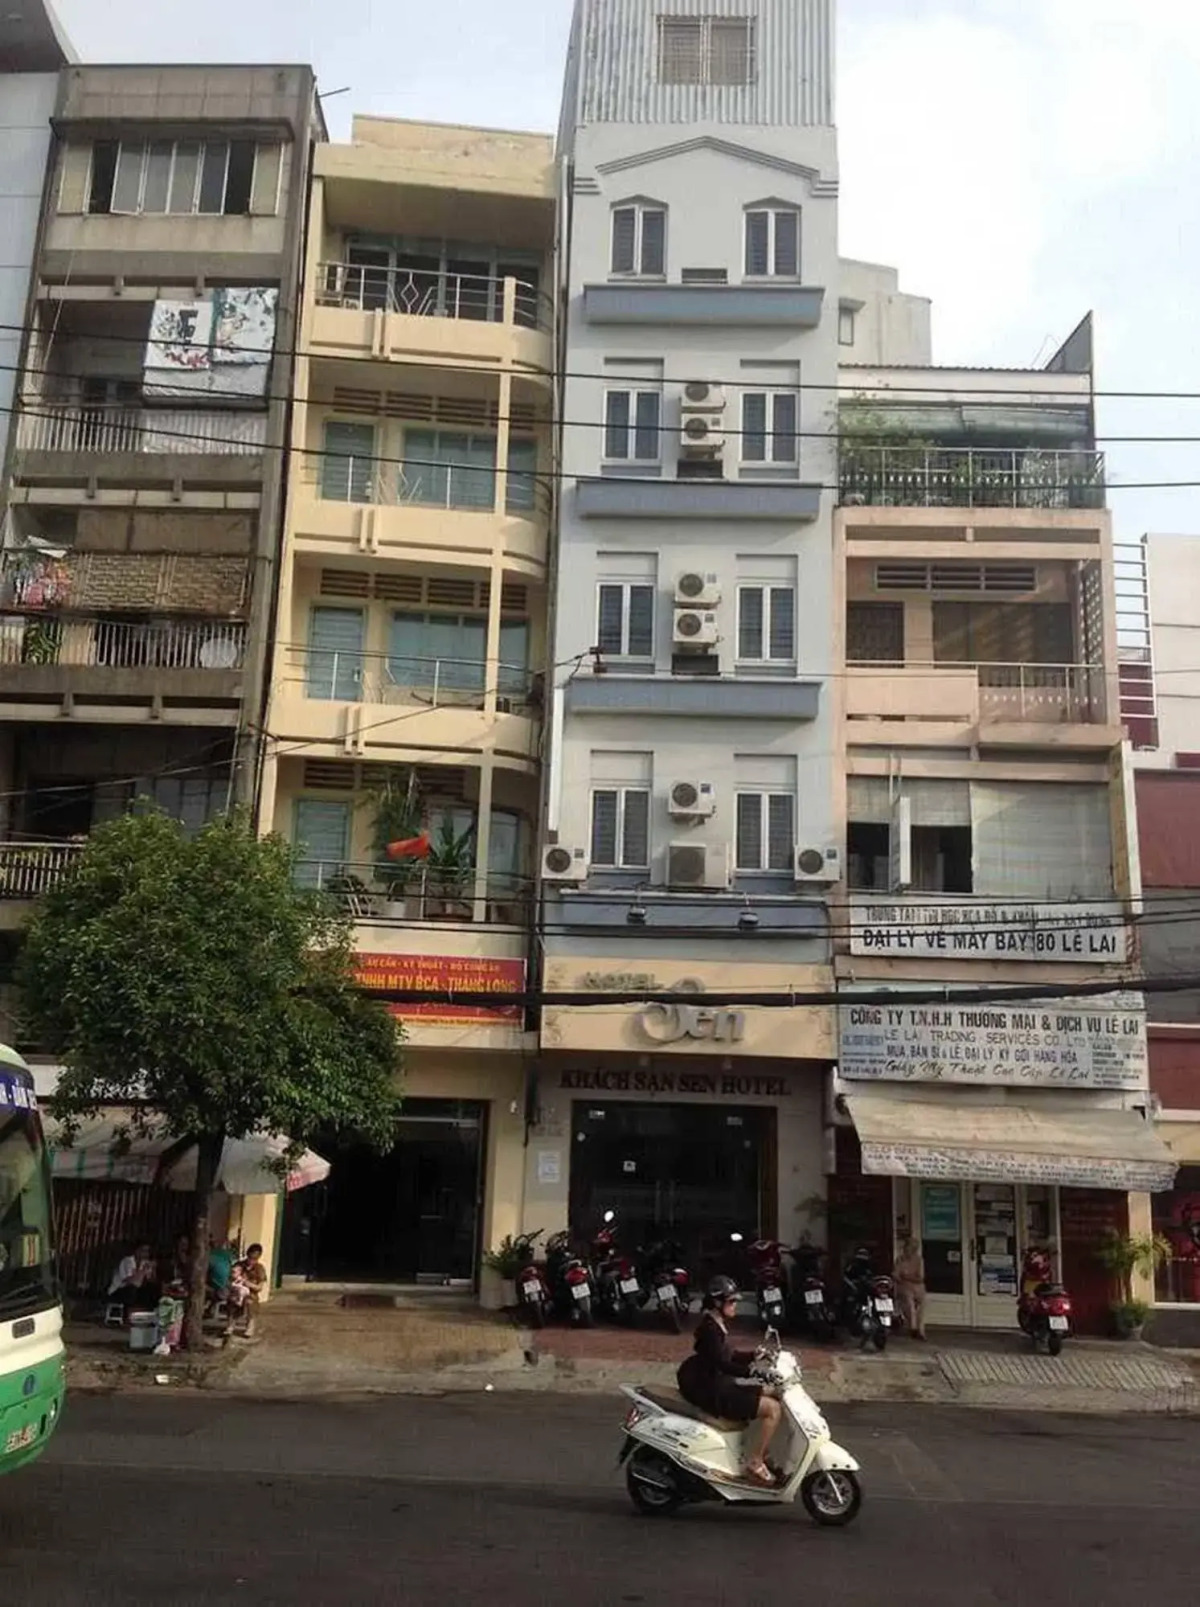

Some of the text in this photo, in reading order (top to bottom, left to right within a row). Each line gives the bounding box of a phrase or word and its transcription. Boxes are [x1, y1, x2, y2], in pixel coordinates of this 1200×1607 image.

[995, 931, 1028, 951] BAY
[1036, 933, 1056, 951] 80
[1090, 934, 1116, 953] LAI
[387, 974, 413, 990] MTV
[850, 1007, 882, 1025] CÔNG
[888, 1010, 904, 1025] TY
[1041, 1015, 1052, 1032] &
[1123, 1019, 1139, 1035] LAI
[930, 1030, 977, 1044] TRADING
[560, 1064, 793, 1097] KHÁCH SẠN SEN HOTEL
